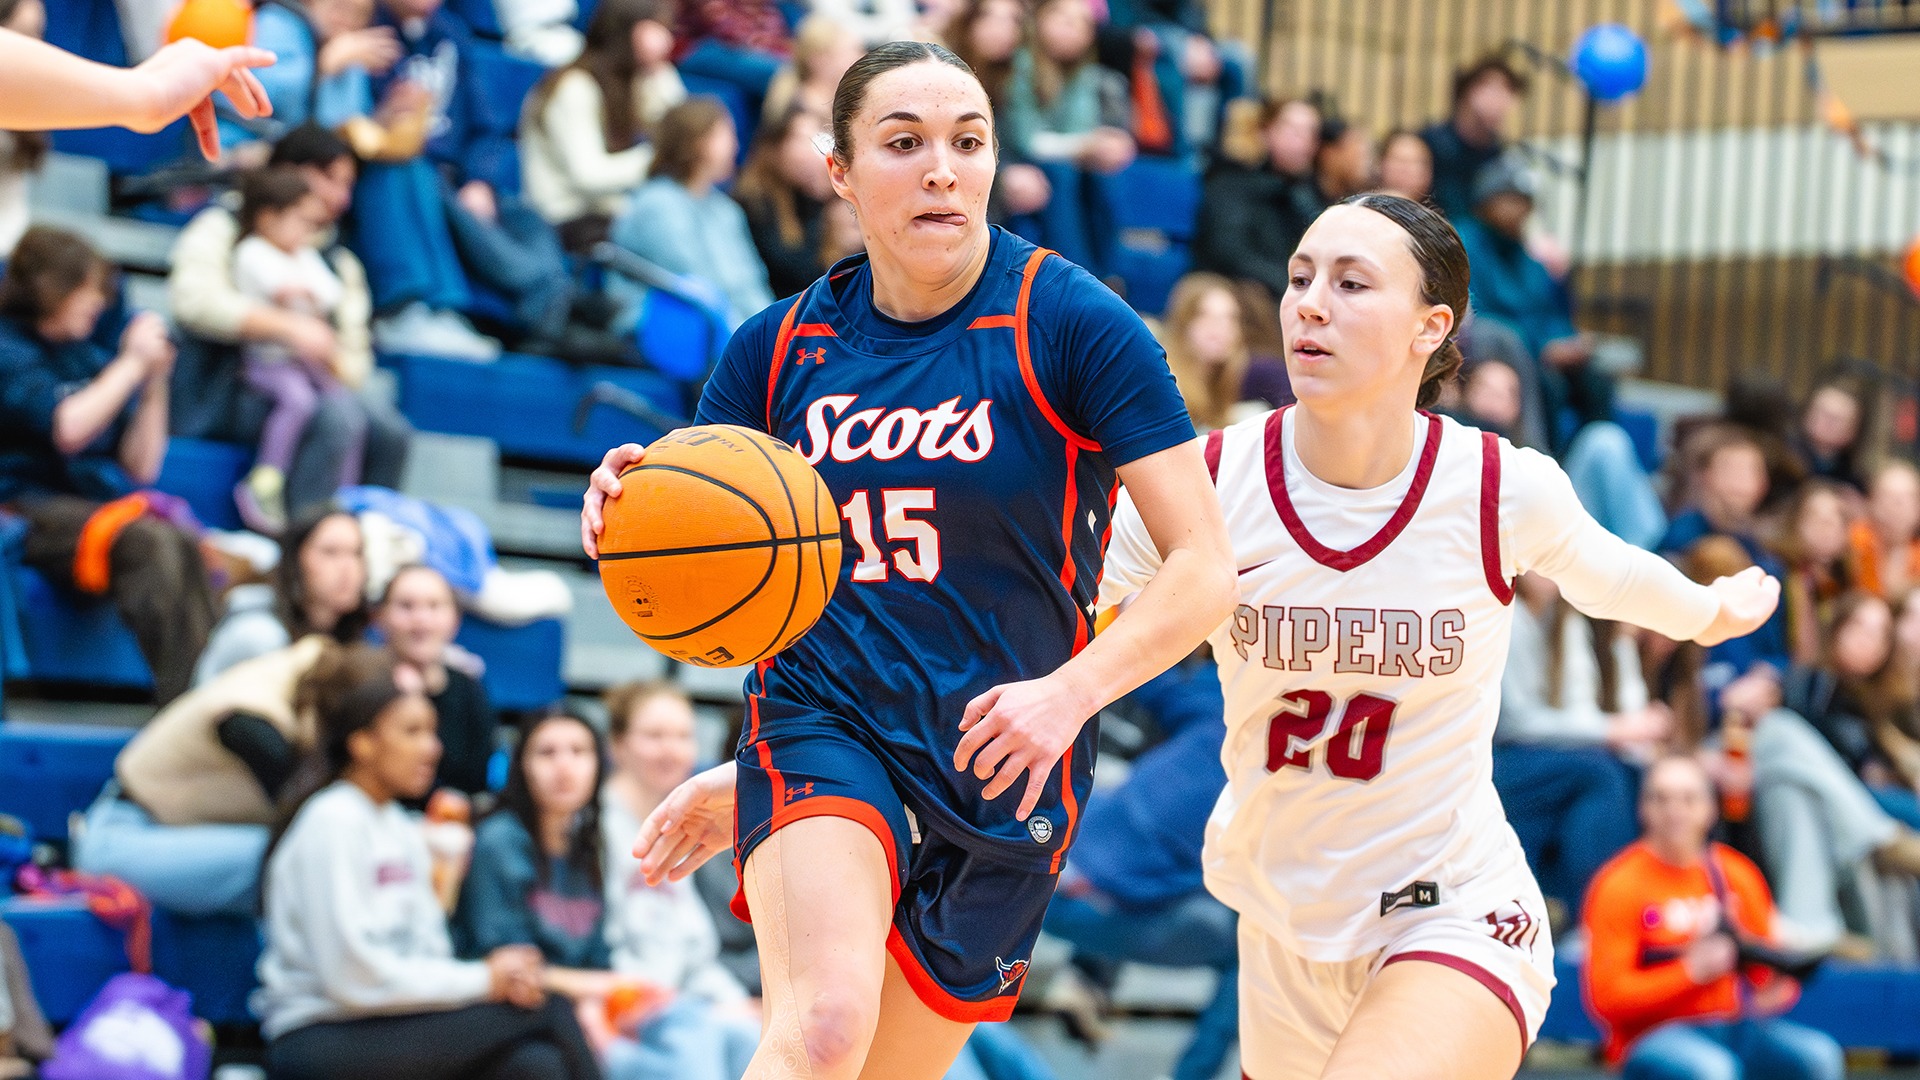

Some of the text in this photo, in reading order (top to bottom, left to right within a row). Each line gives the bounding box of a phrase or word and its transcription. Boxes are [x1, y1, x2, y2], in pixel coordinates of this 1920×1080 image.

[795, 394, 993, 466] Scots
[840, 487, 942, 584] 15
[1230, 603, 1466, 678] PIPERS
[1262, 688, 1403, 784] 20
[1418, 889, 1432, 902] M
